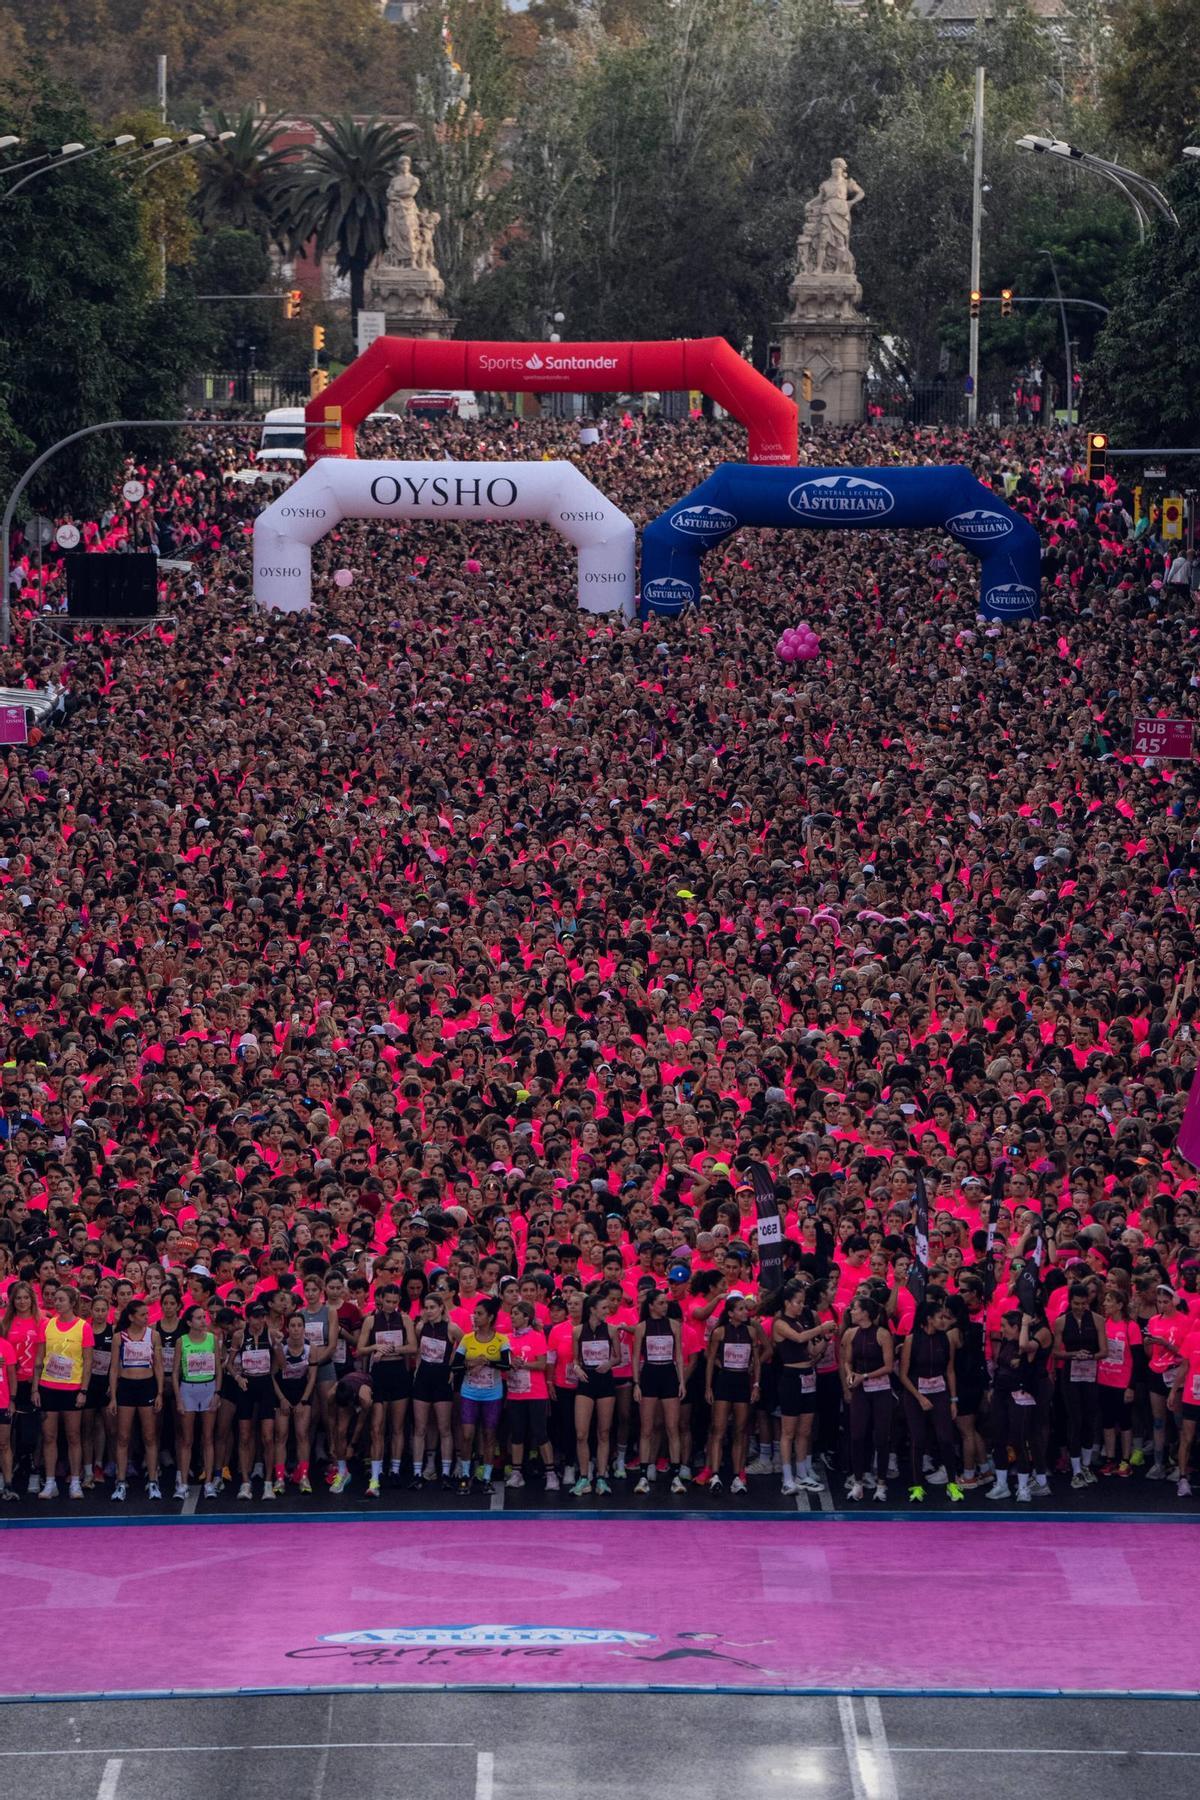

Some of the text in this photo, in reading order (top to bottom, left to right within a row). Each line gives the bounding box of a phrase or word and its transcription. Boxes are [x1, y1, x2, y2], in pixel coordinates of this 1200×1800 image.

[479, 355, 618, 371] Sports Santander
[370, 475, 518, 507] OYSHO
[796, 490, 886, 510] ASTURIANA
[281, 507, 326, 519] OYSHO
[560, 511, 605, 522] OYSHO
[675, 514, 732, 529] ASTURIANA
[951, 521, 1009, 533] ASTURIANA
[259, 567, 302, 578] OYSHO
[584, 572, 627, 583] OYSHO
[1138, 722, 1166, 734] SUB
[285, 1646, 563, 1659] Carrera
[417, 1656, 450, 1666] la
